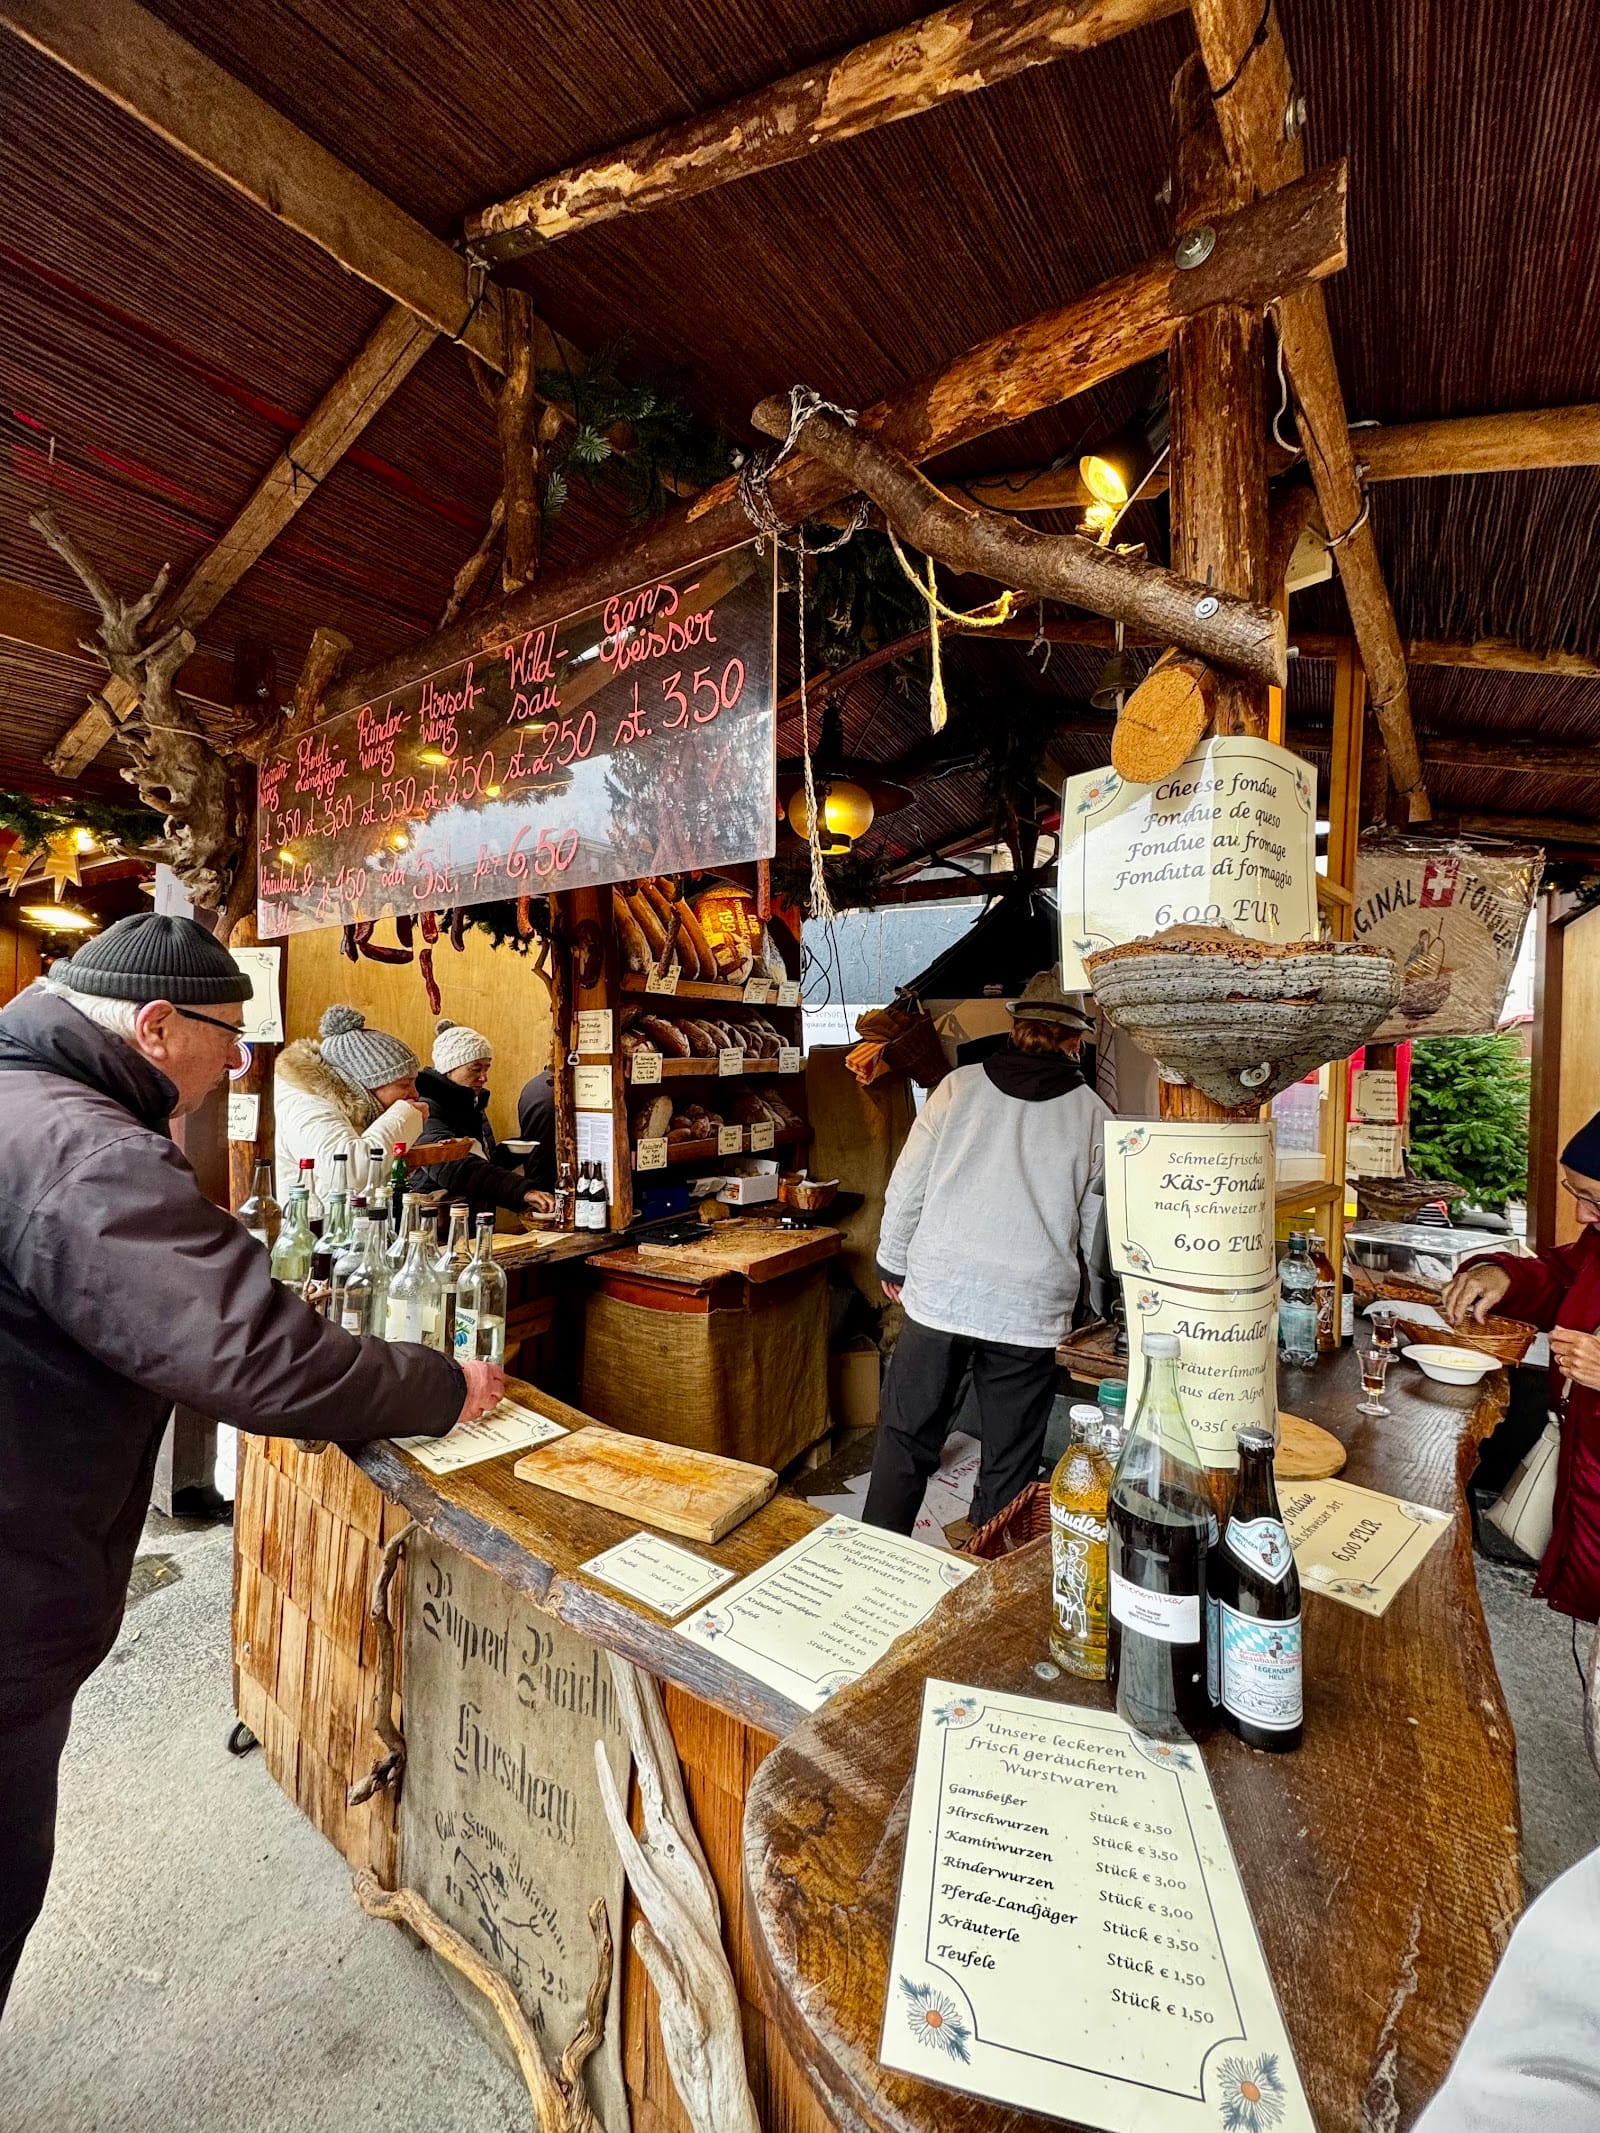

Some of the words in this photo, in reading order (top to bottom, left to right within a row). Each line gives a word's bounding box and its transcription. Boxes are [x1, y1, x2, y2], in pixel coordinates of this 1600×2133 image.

[357, 701, 411, 751] Rinder-
[419, 662, 485, 722] Hirsch-
[505, 623, 568, 690] Wild-
[323, 794, 353, 840] 3,50
[360, 782, 378, 827] st.
[380, 776, 416, 824] 3,50
[421, 762, 442, 810] st.
[444, 750, 495, 805] 3,50
[503, 731, 532, 784] st.
[532, 710, 596, 774] 2,50
[612, 682, 653, 747] st.
[662, 657, 746, 729] 3,50
[359, 739, 397, 777] wurz
[420, 716, 459, 756] wurz
[507, 684, 561, 724] sau
[1156, 775, 1224, 801] Cheese
[1229, 772, 1277, 798] fondue
[1141, 804, 1222, 834] Fondue
[1229, 801, 1250, 820] de
[1255, 807, 1281, 829] queso
[506, 824, 579, 880] 6,50
[1125, 834, 1205, 863] Fondue
[1213, 833, 1239, 848] au
[1241, 830, 1287, 861] fromage
[1113, 863, 1206, 892] Fonduta
[1212, 857, 1234, 876] di
[1234, 859, 1293, 889] formaggio
[1233, 899, 1281, 926] EUR
[1353, 878, 1417, 941] GINAL
[1154, 1199, 1191, 1213] nach
[1194, 1202, 1257, 1215] schweizer
[1174, 1233, 1221, 1252] 6,00
[1228, 1233, 1264, 1252] EUR
[1173, 1319, 1269, 1342] Almdudler
[1179, 1384, 1204, 1398] aus
[1208, 1388, 1235, 1401] den
[851, 1538, 886, 1555] Unsere
[887, 1551, 931, 1573] leckeren
[1331, 1539, 1363, 1562] 6,00
[1348, 1518, 1383, 1543] EUR
[829, 1542, 862, 1557] frisch
[860, 1552, 932, 1585] geräucherten
[843, 1555, 906, 1585] Wurstwaren
[1254, 1664, 1296, 1674] TEGERNSEER
[1268, 1673, 1285, 1681] HELL
[965, 1735, 1019, 1757] frisch
[1024, 1749, 1147, 1781] geräucherten
[986, 1722, 1047, 1744] Unsere
[1053, 1735, 1126, 1759] leckeren
[452, 1701, 580, 1846] Hirschegg
[1000, 1759, 1119, 1795] Wurstwaren
[949, 1783, 1028, 1808] Gamsbeißer
[1089, 1810, 1129, 1828] Stück
[1133, 1821, 1141, 1830] €
[1144, 1822, 1173, 1836] 3,50
[946, 1805, 1049, 1837] Hirschwurzen
[1092, 1835, 1133, 1854] Stück
[1138, 1845, 1146, 1855] €
[1149, 1847, 1179, 1863] 3,50
[944, 1829, 1054, 1863] Kaminwurzen
[1095, 1862, 1138, 1881] Stück
[1142, 1873, 1150, 1883] €
[1154, 1875, 1187, 1891] 3,00
[943, 1856, 1054, 1890] Rinderwurzen
[1099, 1890, 1144, 1910] Stück
[1148, 1902, 1157, 1913] €
[1160, 1905, 1194, 1921] 3,00
[941, 1884, 1078, 1926] Pferde-Landjäger
[1103, 1920, 1149, 1942] Stück
[1153, 1933, 1162, 1944] €
[1167, 1936, 1200, 1953] 3,50
[937, 1913, 1021, 1943] Kräuterle
[1107, 1953, 1155, 1976] Stück
[1159, 1967, 1169, 1979] €
[1174, 1970, 1206, 1988] 1,50
[937, 1945, 997, 1971] Teufele
[1111, 1988, 1161, 2013] Stück
[1166, 2004, 1177, 2016] €
[1182, 2007, 1215, 2025] 1,50
